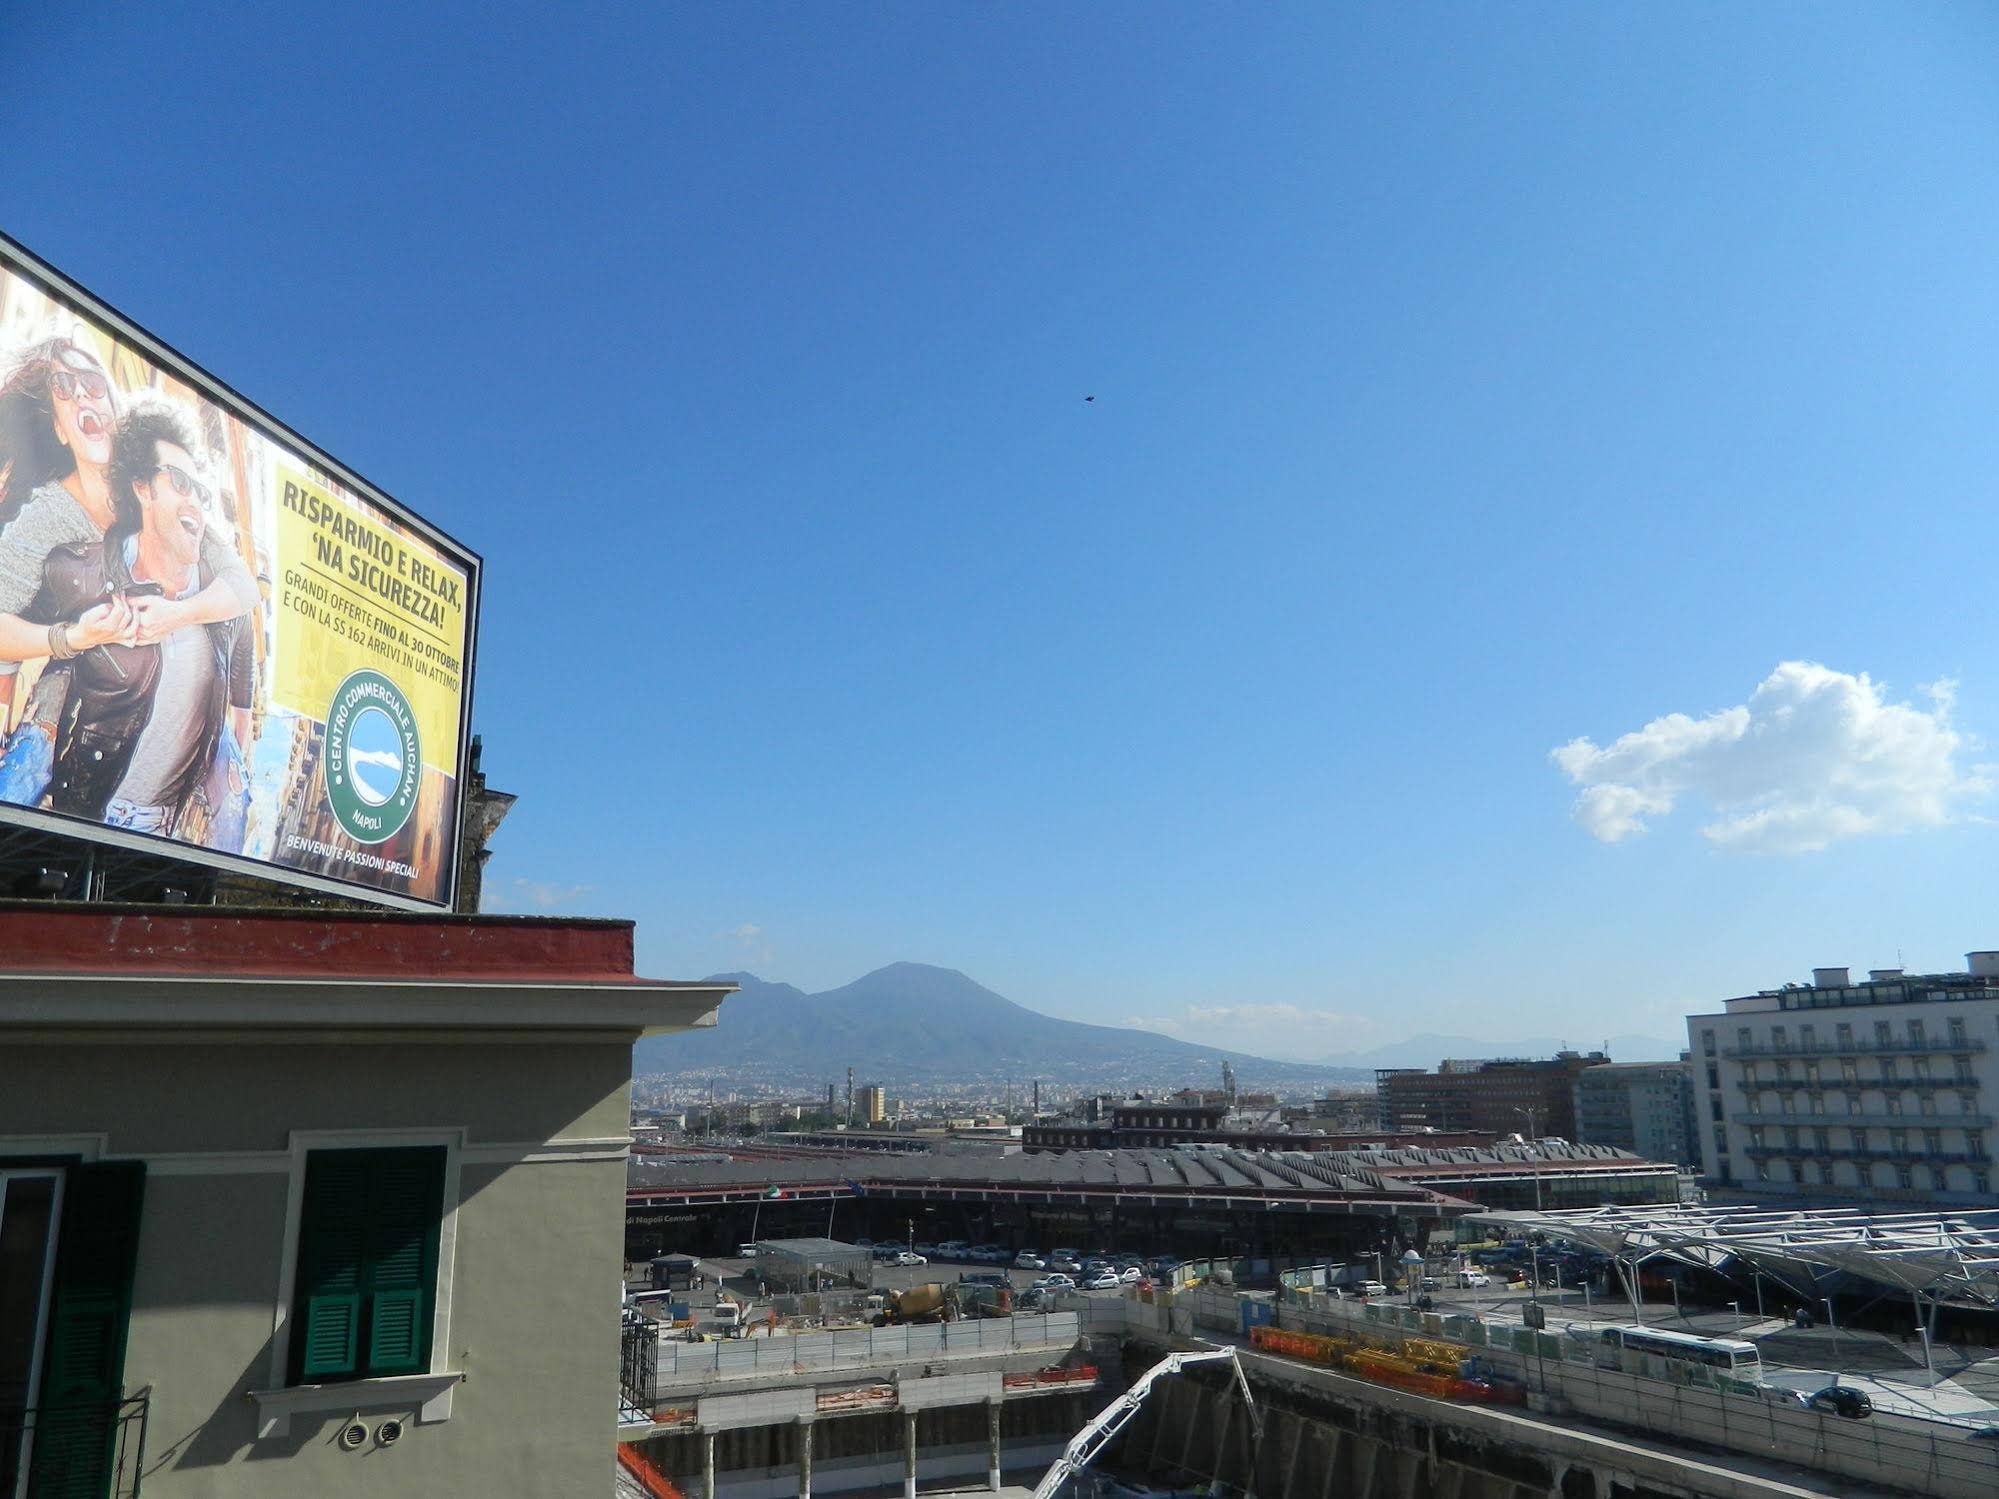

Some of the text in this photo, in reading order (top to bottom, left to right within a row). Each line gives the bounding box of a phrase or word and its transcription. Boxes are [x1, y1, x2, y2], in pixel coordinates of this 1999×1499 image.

[283, 480, 462, 614] RISPARMIO E RELAX,
[285, 569, 460, 674] GRANDI OFFERTE FINO AL 30 OTTOBRE
[349, 553, 446, 630] SICUREZZA!
[283, 590, 291, 607] E
[293, 596, 317, 621] CON
[318, 607, 332, 628] LA
[332, 617, 346, 635] SS
[347, 625, 365, 646] 162
[367, 636, 401, 665] ARRIVI
[402, 652, 414, 669] IN
[415, 658, 428, 676] UN
[331, 682, 417, 799] CENTRO COMMERCIALE AUCHAN
[286, 834, 420, 879] BENVENUTE PASSIONI SPECIALI
[352, 809, 383, 830] NAPOLI
[635, 1215, 664, 1225] Napoli
[664, 1214, 697, 1223] Centrale
